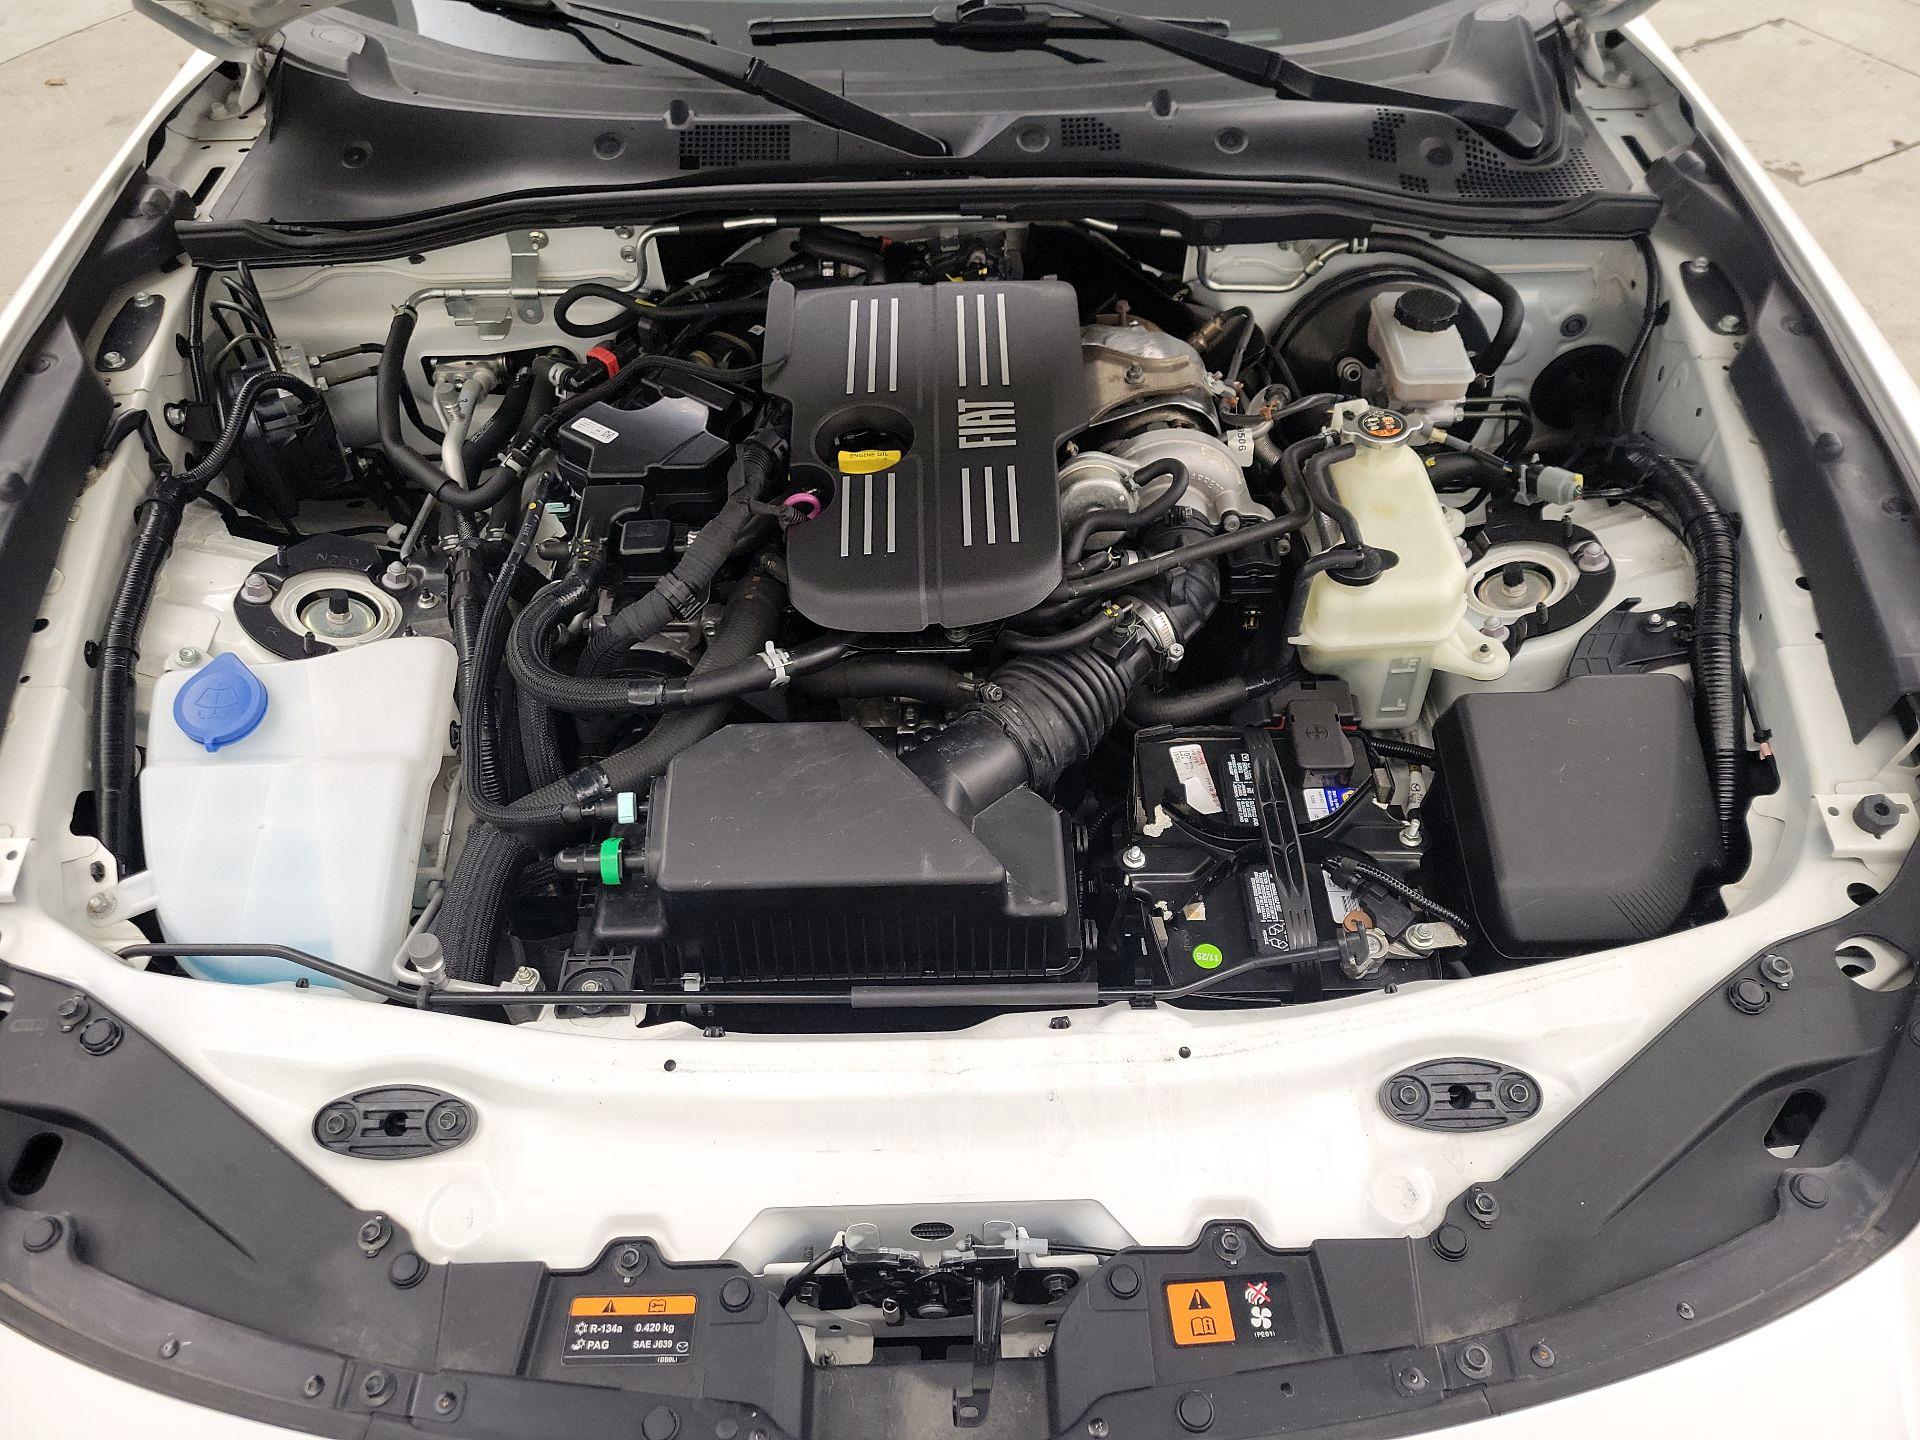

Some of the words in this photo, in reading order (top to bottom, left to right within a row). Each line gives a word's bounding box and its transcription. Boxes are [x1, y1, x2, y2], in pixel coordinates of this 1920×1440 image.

[958, 398, 1017, 449] FIAT
[1196, 952, 1220, 962] 11/25
[590, 1323, 623, 1333] R-134a
[635, 1322, 661, 1333] 0.420
[662, 1322, 675, 1334] kg
[587, 1340, 610, 1350] PAG
[633, 1340, 651, 1349] SAE
[652, 1339, 673, 1349] J639
